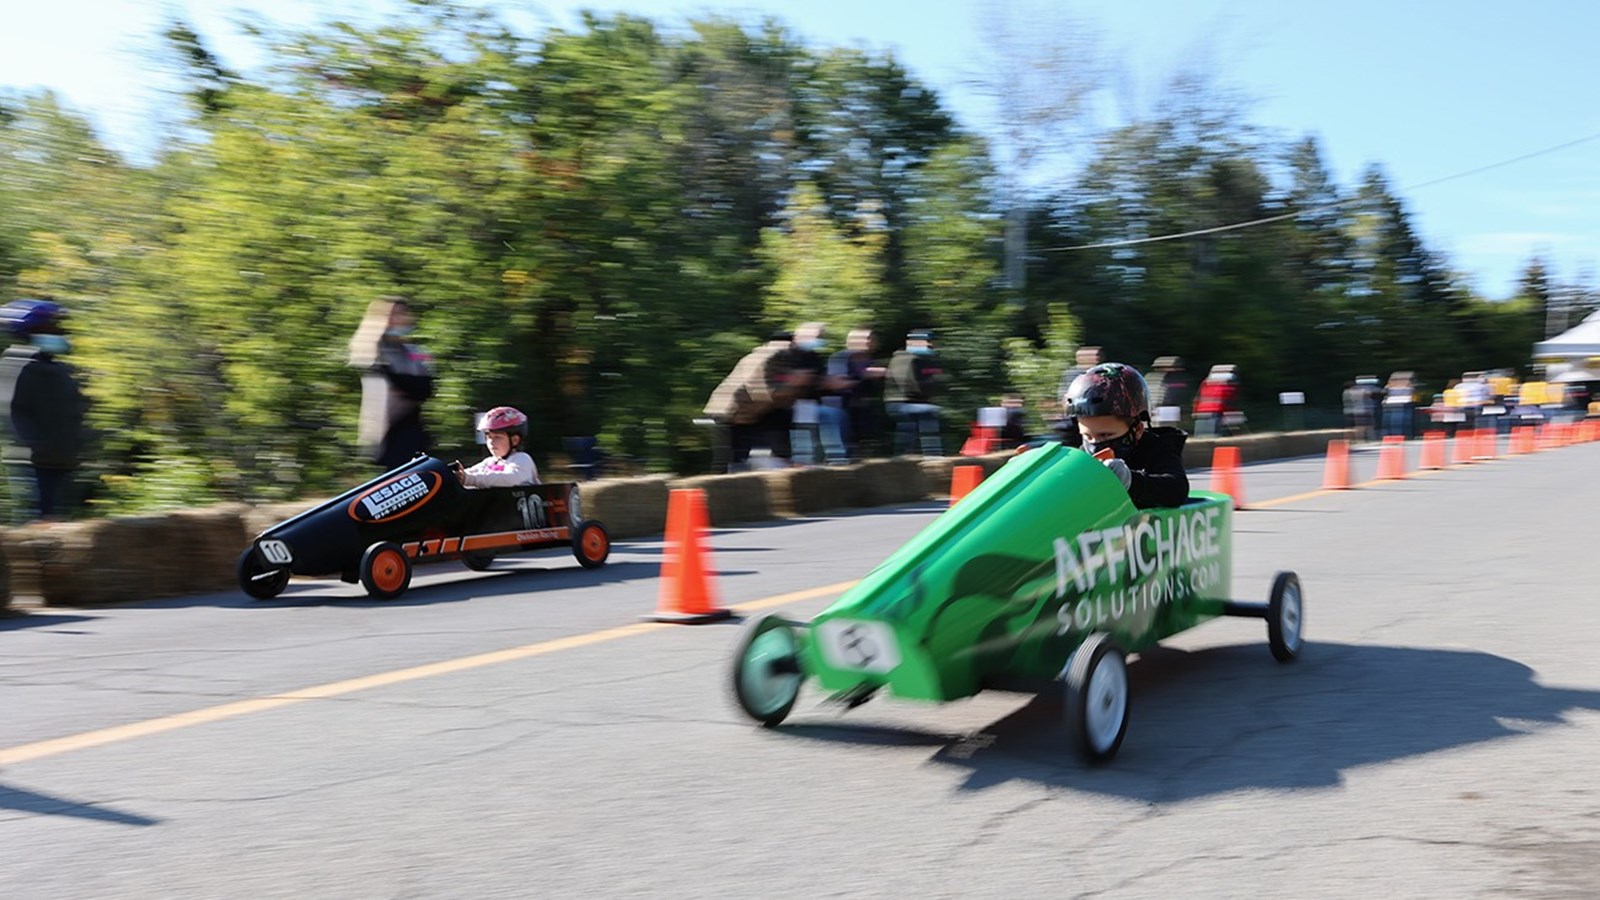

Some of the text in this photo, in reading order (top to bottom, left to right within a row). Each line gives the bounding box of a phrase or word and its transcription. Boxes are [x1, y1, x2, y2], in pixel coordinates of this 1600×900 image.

[361, 473, 422, 516] LESAGE
[517, 493, 545, 529] 10
[264, 543, 288, 562] 10
[1053, 507, 1220, 598] AFFICHAGE
[1056, 561, 1220, 636] SOLUTIONS.COM
